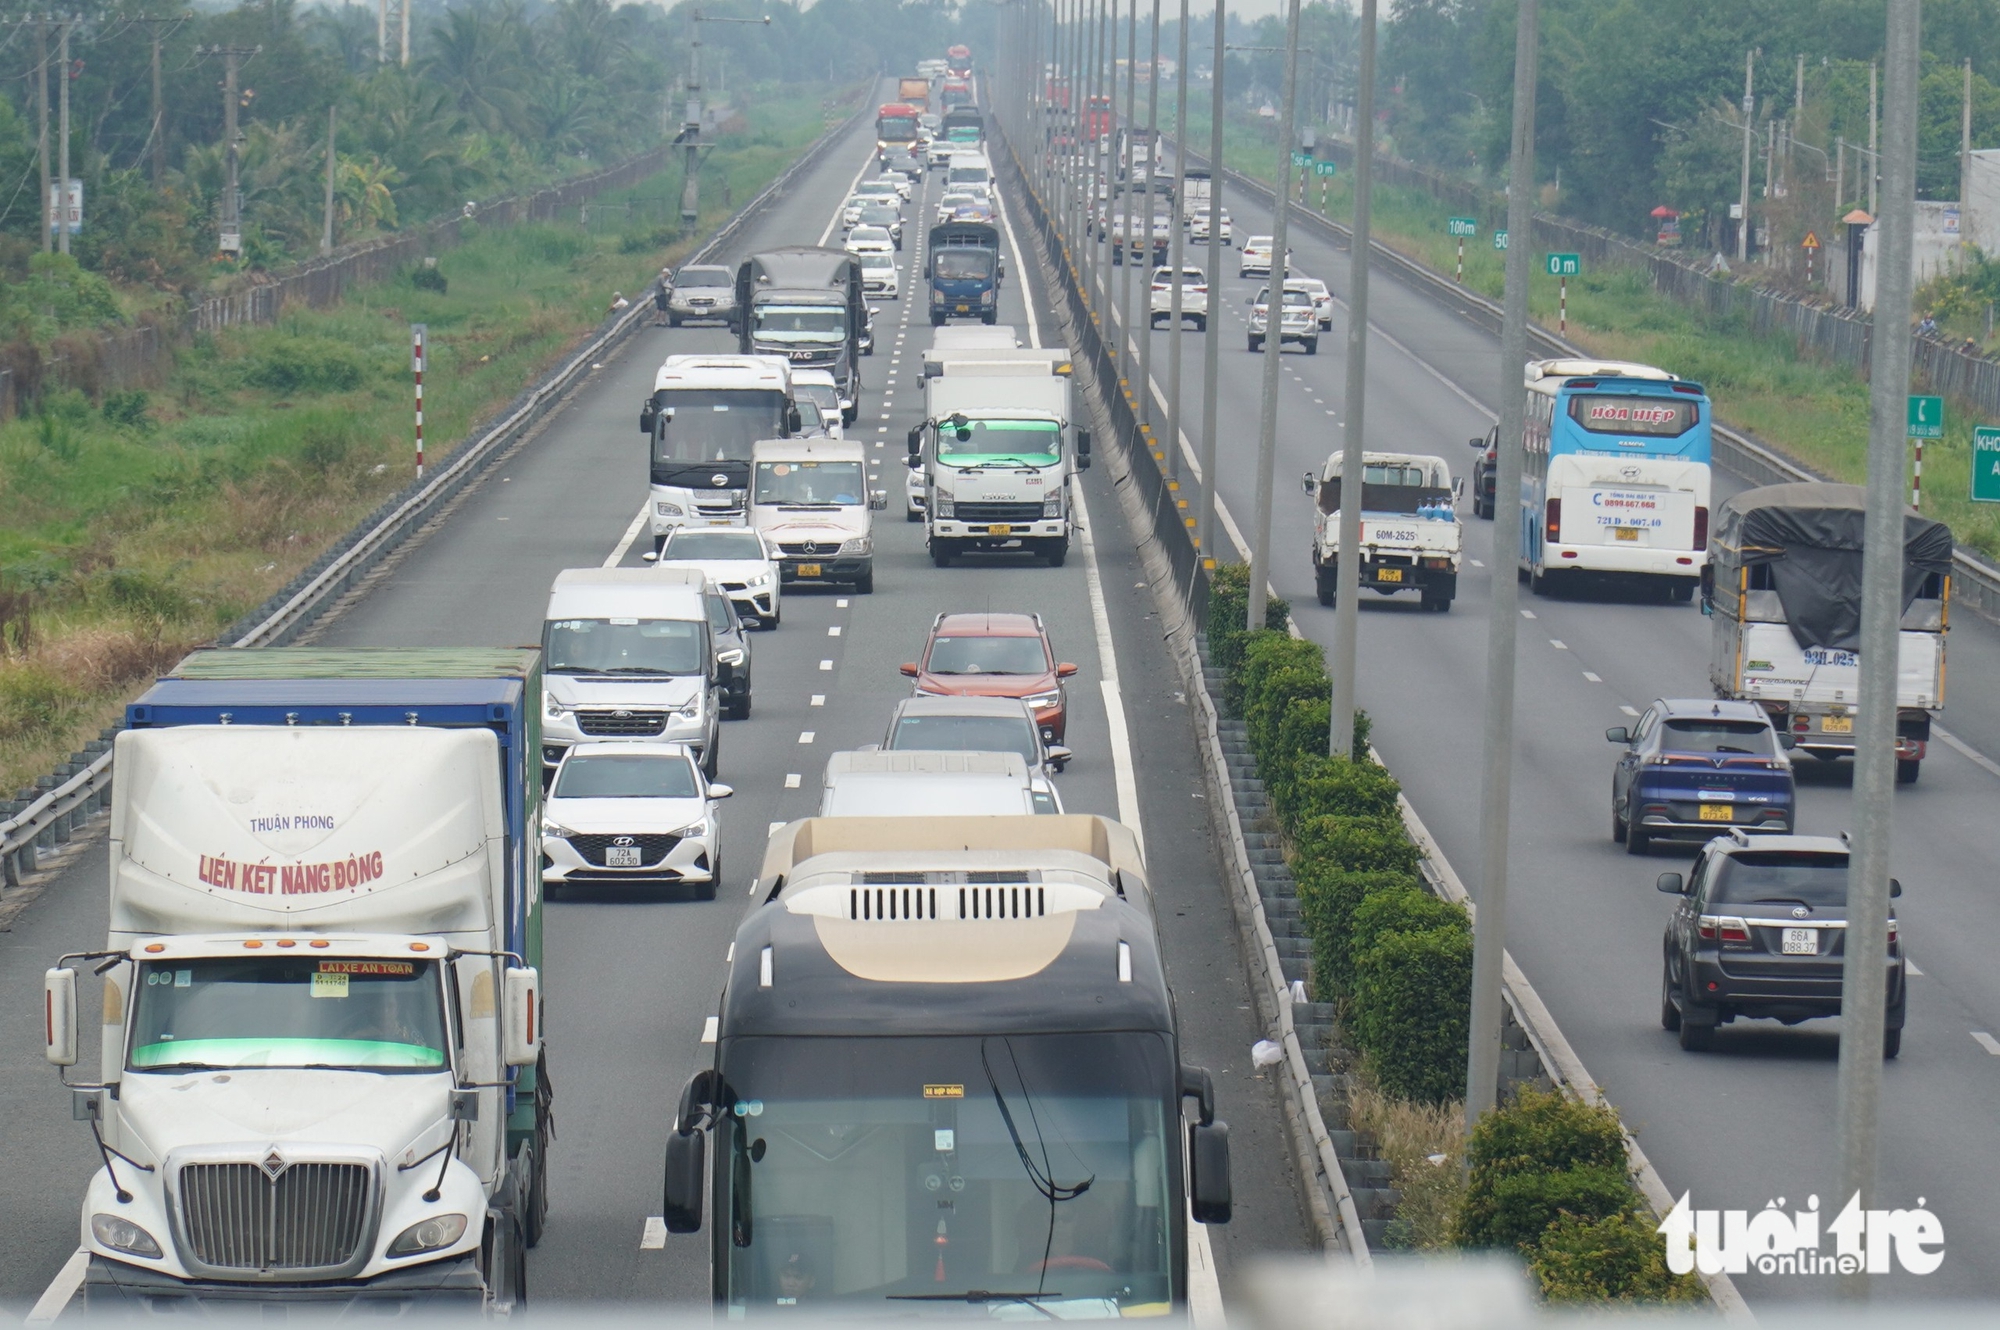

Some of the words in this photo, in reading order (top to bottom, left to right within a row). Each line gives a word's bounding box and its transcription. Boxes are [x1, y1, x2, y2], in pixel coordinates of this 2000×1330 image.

[1449, 220, 1475, 235] 100m
[1495, 233, 1508, 249] 50
[1550, 256, 1560, 273] 0
[1563, 260, 1575, 273] m
[787, 351, 813, 360] JAC
[1632, 406, 1676, 425] HIỆP
[982, 492, 1016, 500] ISUZU
[1376, 530, 1416, 541] 60M-2625
[1804, 650, 1858, 667] 93H-025.
[250, 814, 290, 833] THUẬN
[294, 816, 334, 830] PHONG
[616, 849, 631, 857] 72A
[241, 856, 277, 895] KẾT
[281, 859, 330, 895] NĂNG
[333, 851, 384, 894] ĐỘNG
[1790, 930, 1809, 941] 66A
[1783, 942, 1816, 953] 088.37
[342, 963, 359, 973] XE
[361, 963, 378, 973] AN
